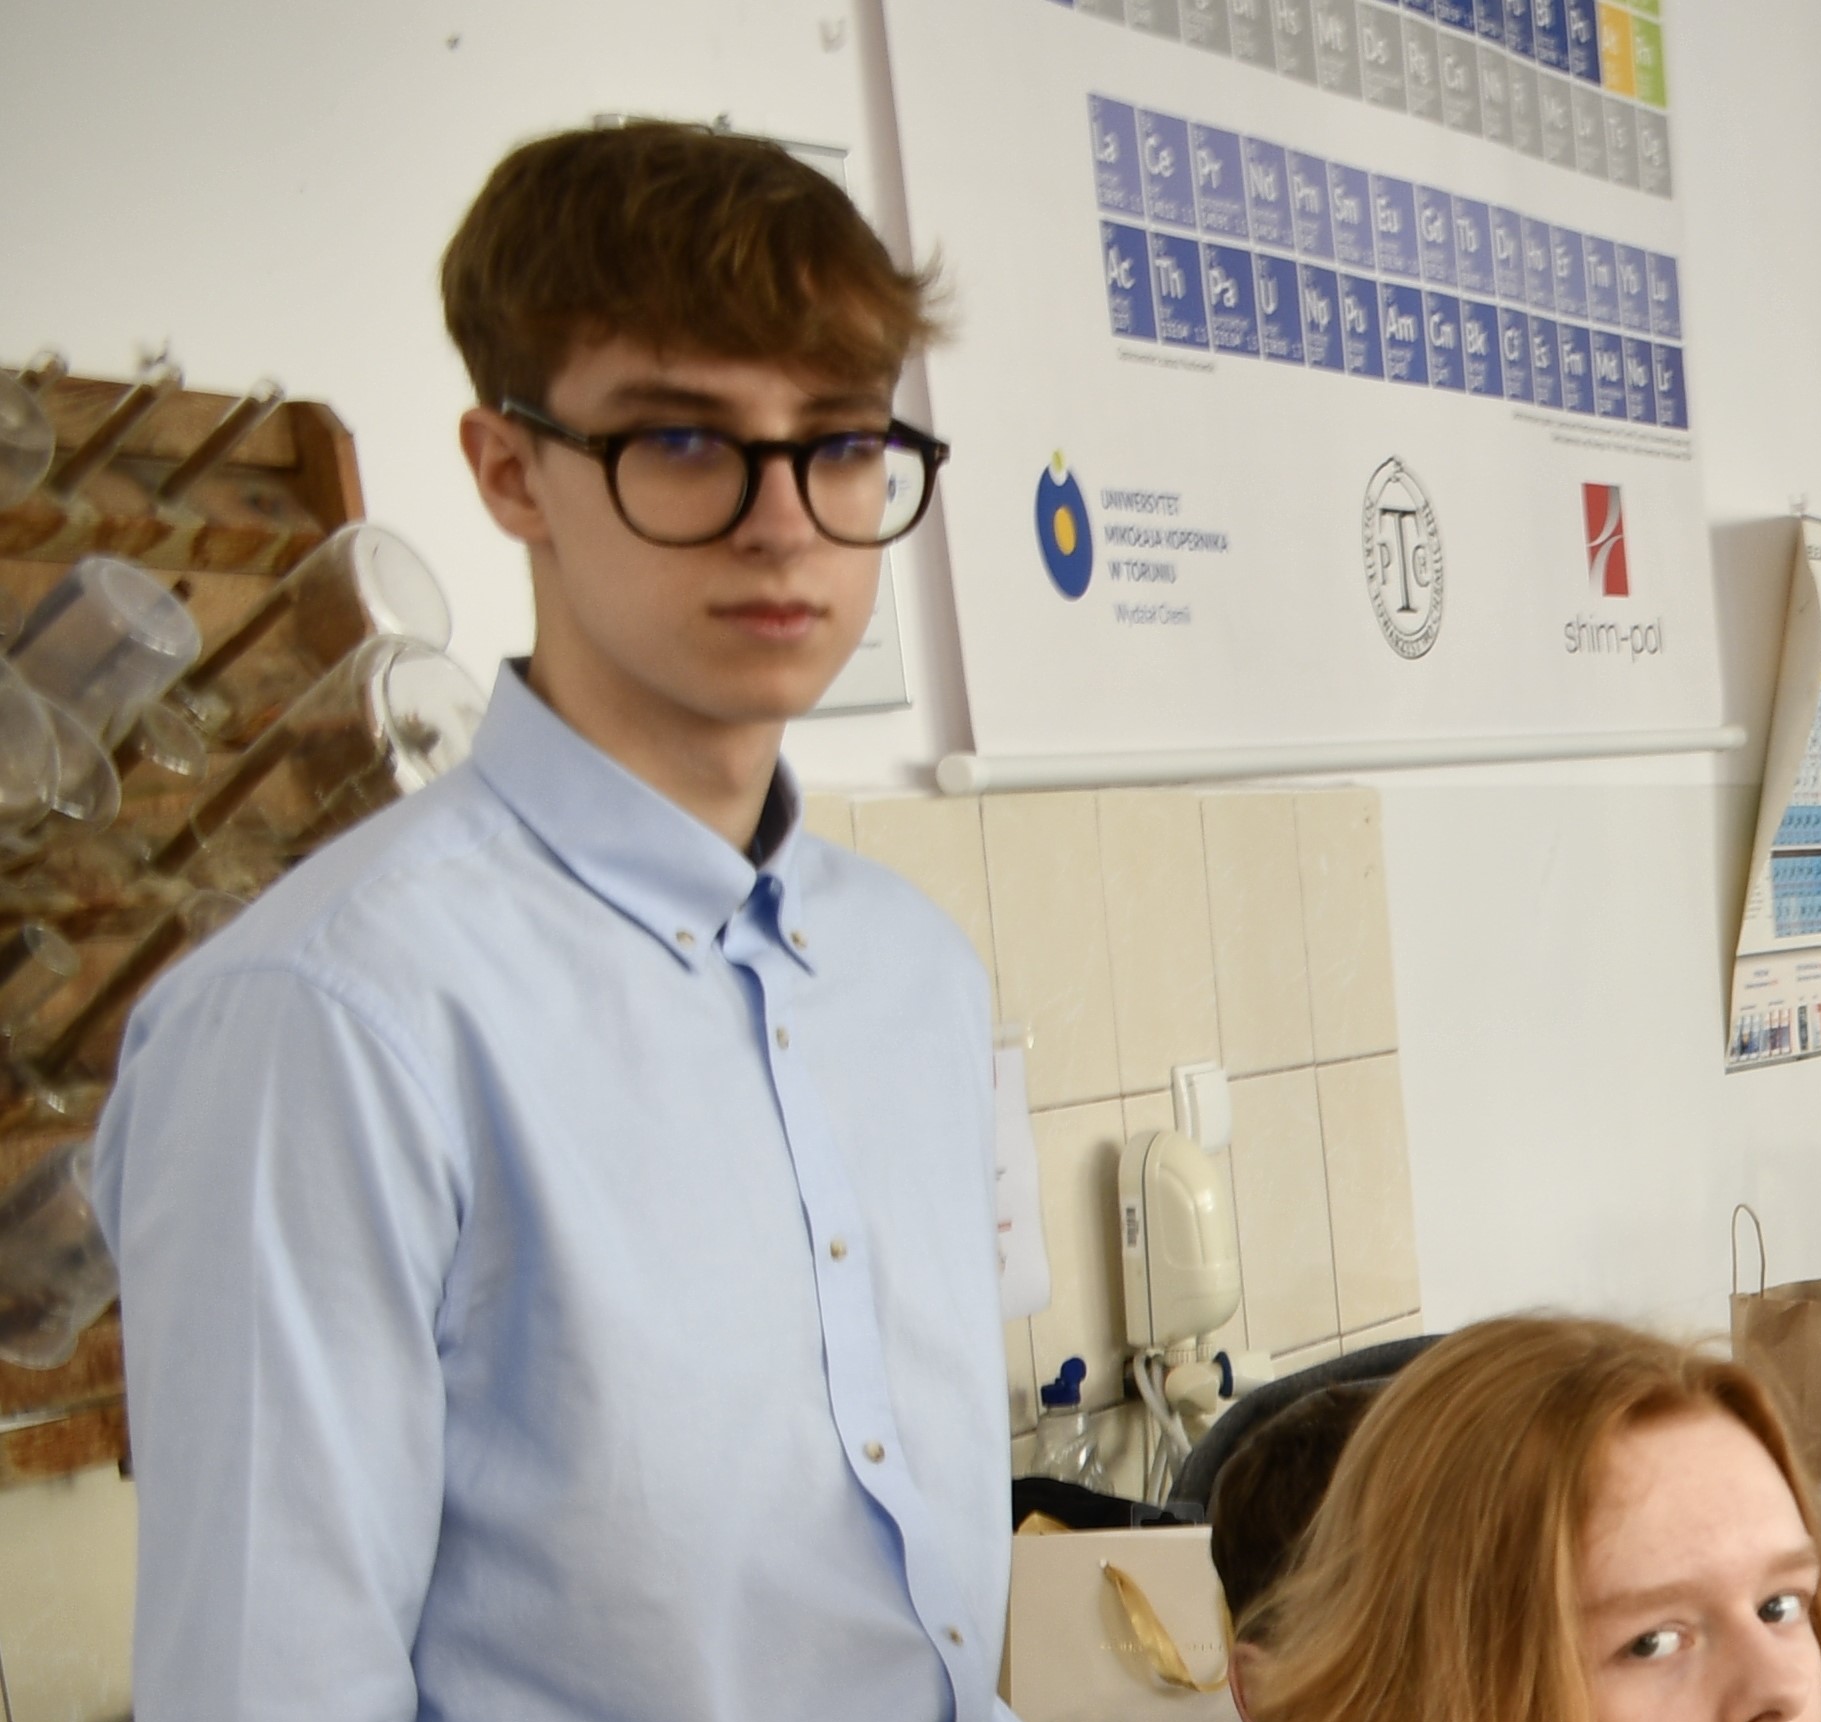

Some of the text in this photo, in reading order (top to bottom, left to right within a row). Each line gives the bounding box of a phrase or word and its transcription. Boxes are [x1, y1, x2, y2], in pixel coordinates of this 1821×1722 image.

[1094, 122, 1118, 163] La
[1145, 133, 1174, 178] Ce
[1198, 147, 1223, 189] Pr
[1251, 163, 1278, 202] Nd
[1294, 175, 1320, 214] Pm
[1334, 187, 1359, 225] Sm
[1377, 197, 1400, 233] Eu
[1421, 207, 1444, 243] Gd
[1456, 219, 1479, 253] Tb
[1587, 256, 1610, 287] Tm
[1107, 245, 1135, 289] Ac
[1155, 258, 1186, 299] Th
[1209, 266, 1239, 308] Pa
[1260, 277, 1278, 315] U
[1304, 288, 1331, 332] Np
[1344, 296, 1368, 333] Pu
[1386, 304, 1418, 343] Am
[1430, 312, 1457, 349] Cm
[1465, 321, 1488, 356] Bk
[1533, 336, 1550, 369] Es
[1563, 342, 1585, 377] Fm
[1595, 351, 1620, 382] Md
[1657, 363, 1674, 392] Lr
[1101, 490, 1180, 516] UNIWERSYTET
[1165, 530, 1229, 553] KOPERNIKA
[1107, 561, 1177, 585] W TORUNIU
[1564, 614, 1664, 663] shim-pol
